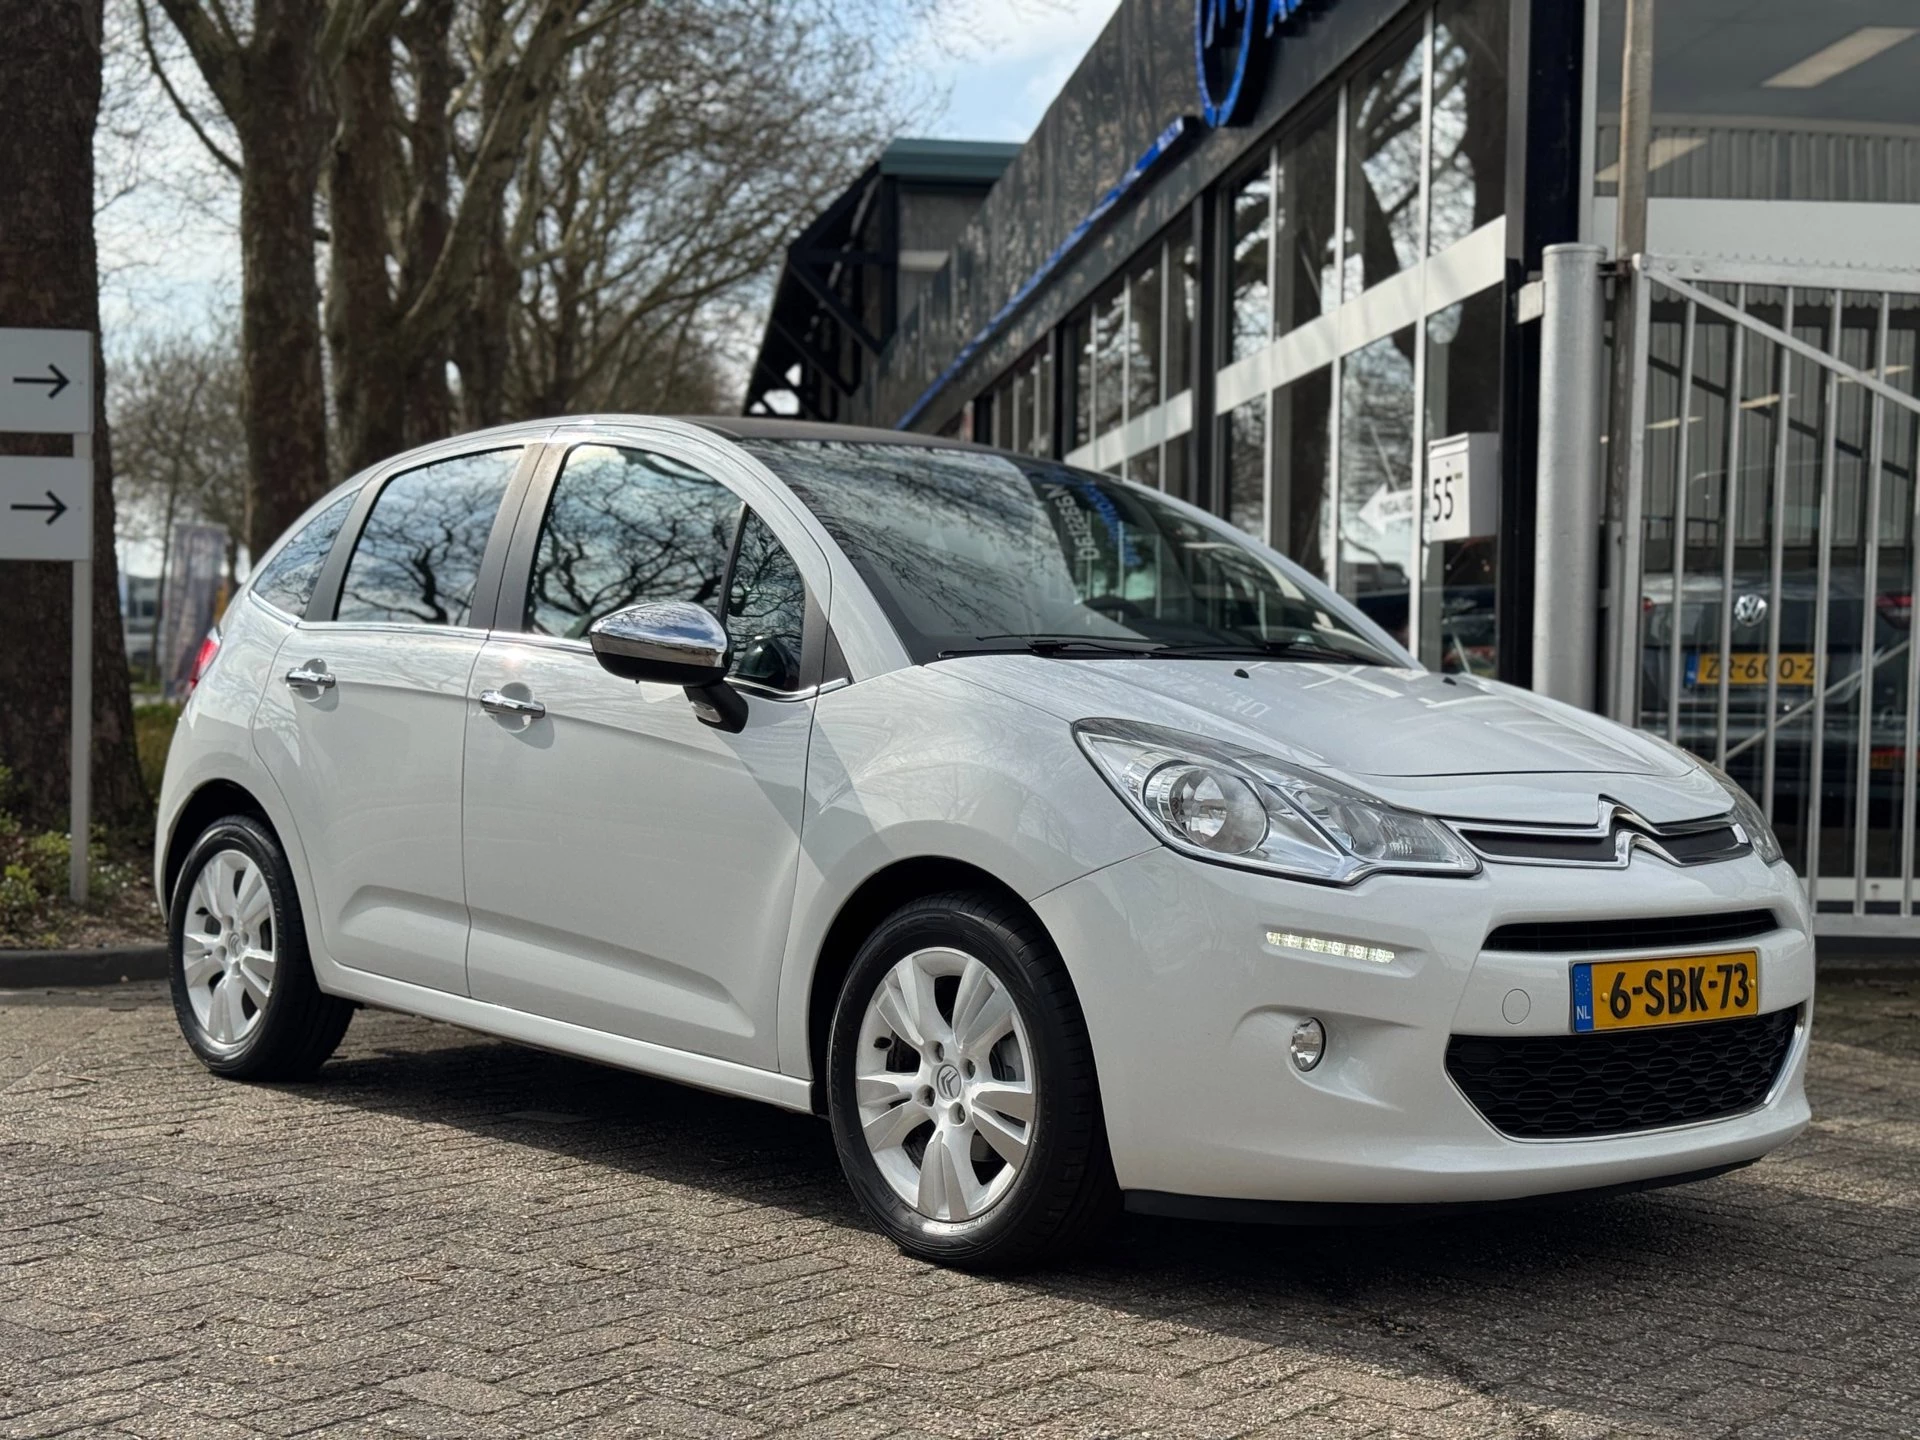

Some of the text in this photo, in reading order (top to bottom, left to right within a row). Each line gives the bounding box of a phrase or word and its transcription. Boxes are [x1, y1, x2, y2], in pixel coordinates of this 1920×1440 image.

[1433, 476, 1454, 522] 55
[1576, 1004, 1591, 1021] NL
[1609, 962, 1750, 1020] 6-SBK-73
